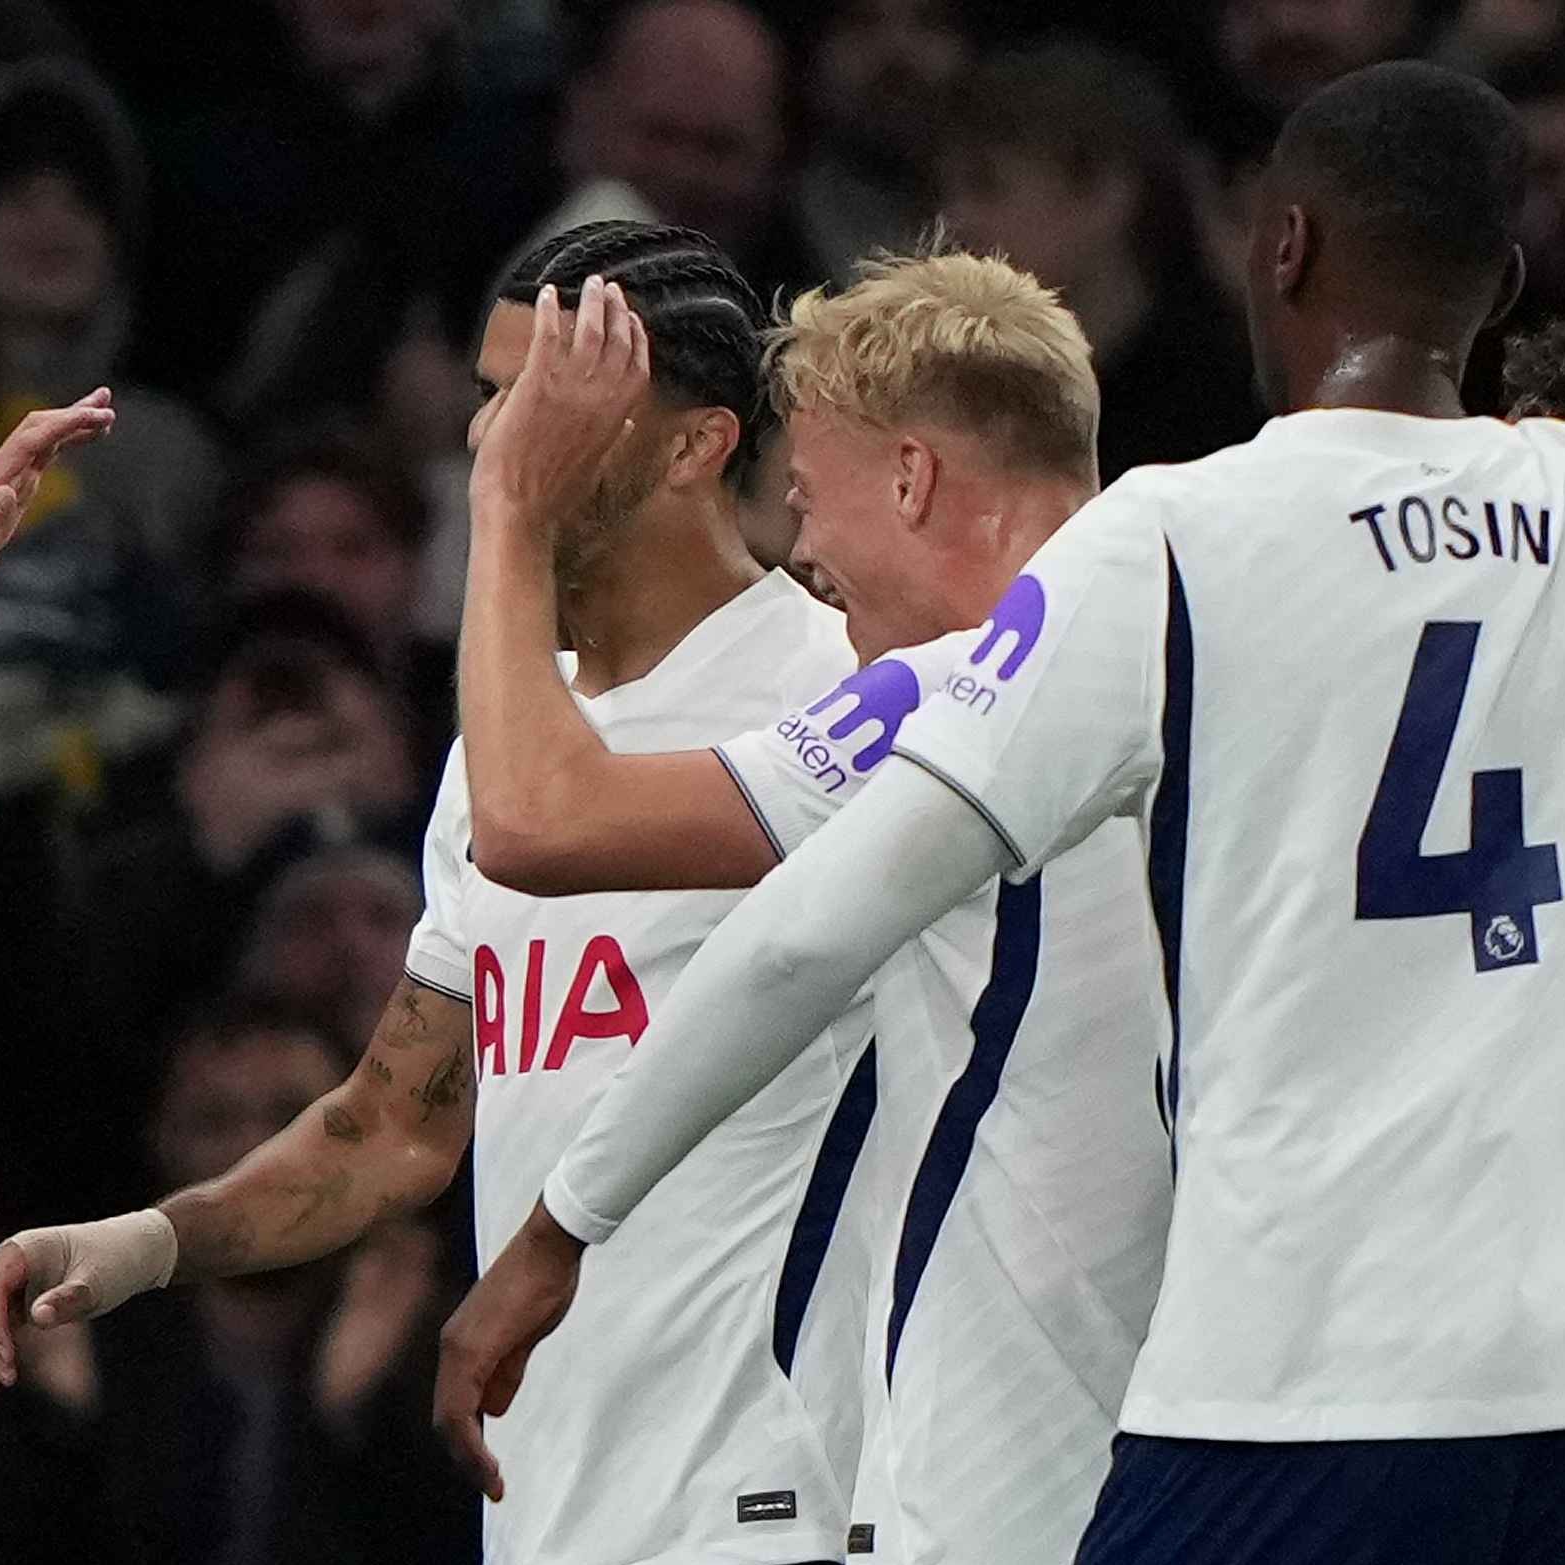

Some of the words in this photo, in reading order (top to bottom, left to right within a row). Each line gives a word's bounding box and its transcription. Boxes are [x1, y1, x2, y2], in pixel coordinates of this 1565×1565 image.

[1349, 495, 1550, 572] TOSIN
[1355, 620, 1564, 973] 4
[473, 935, 650, 1082] AIA
